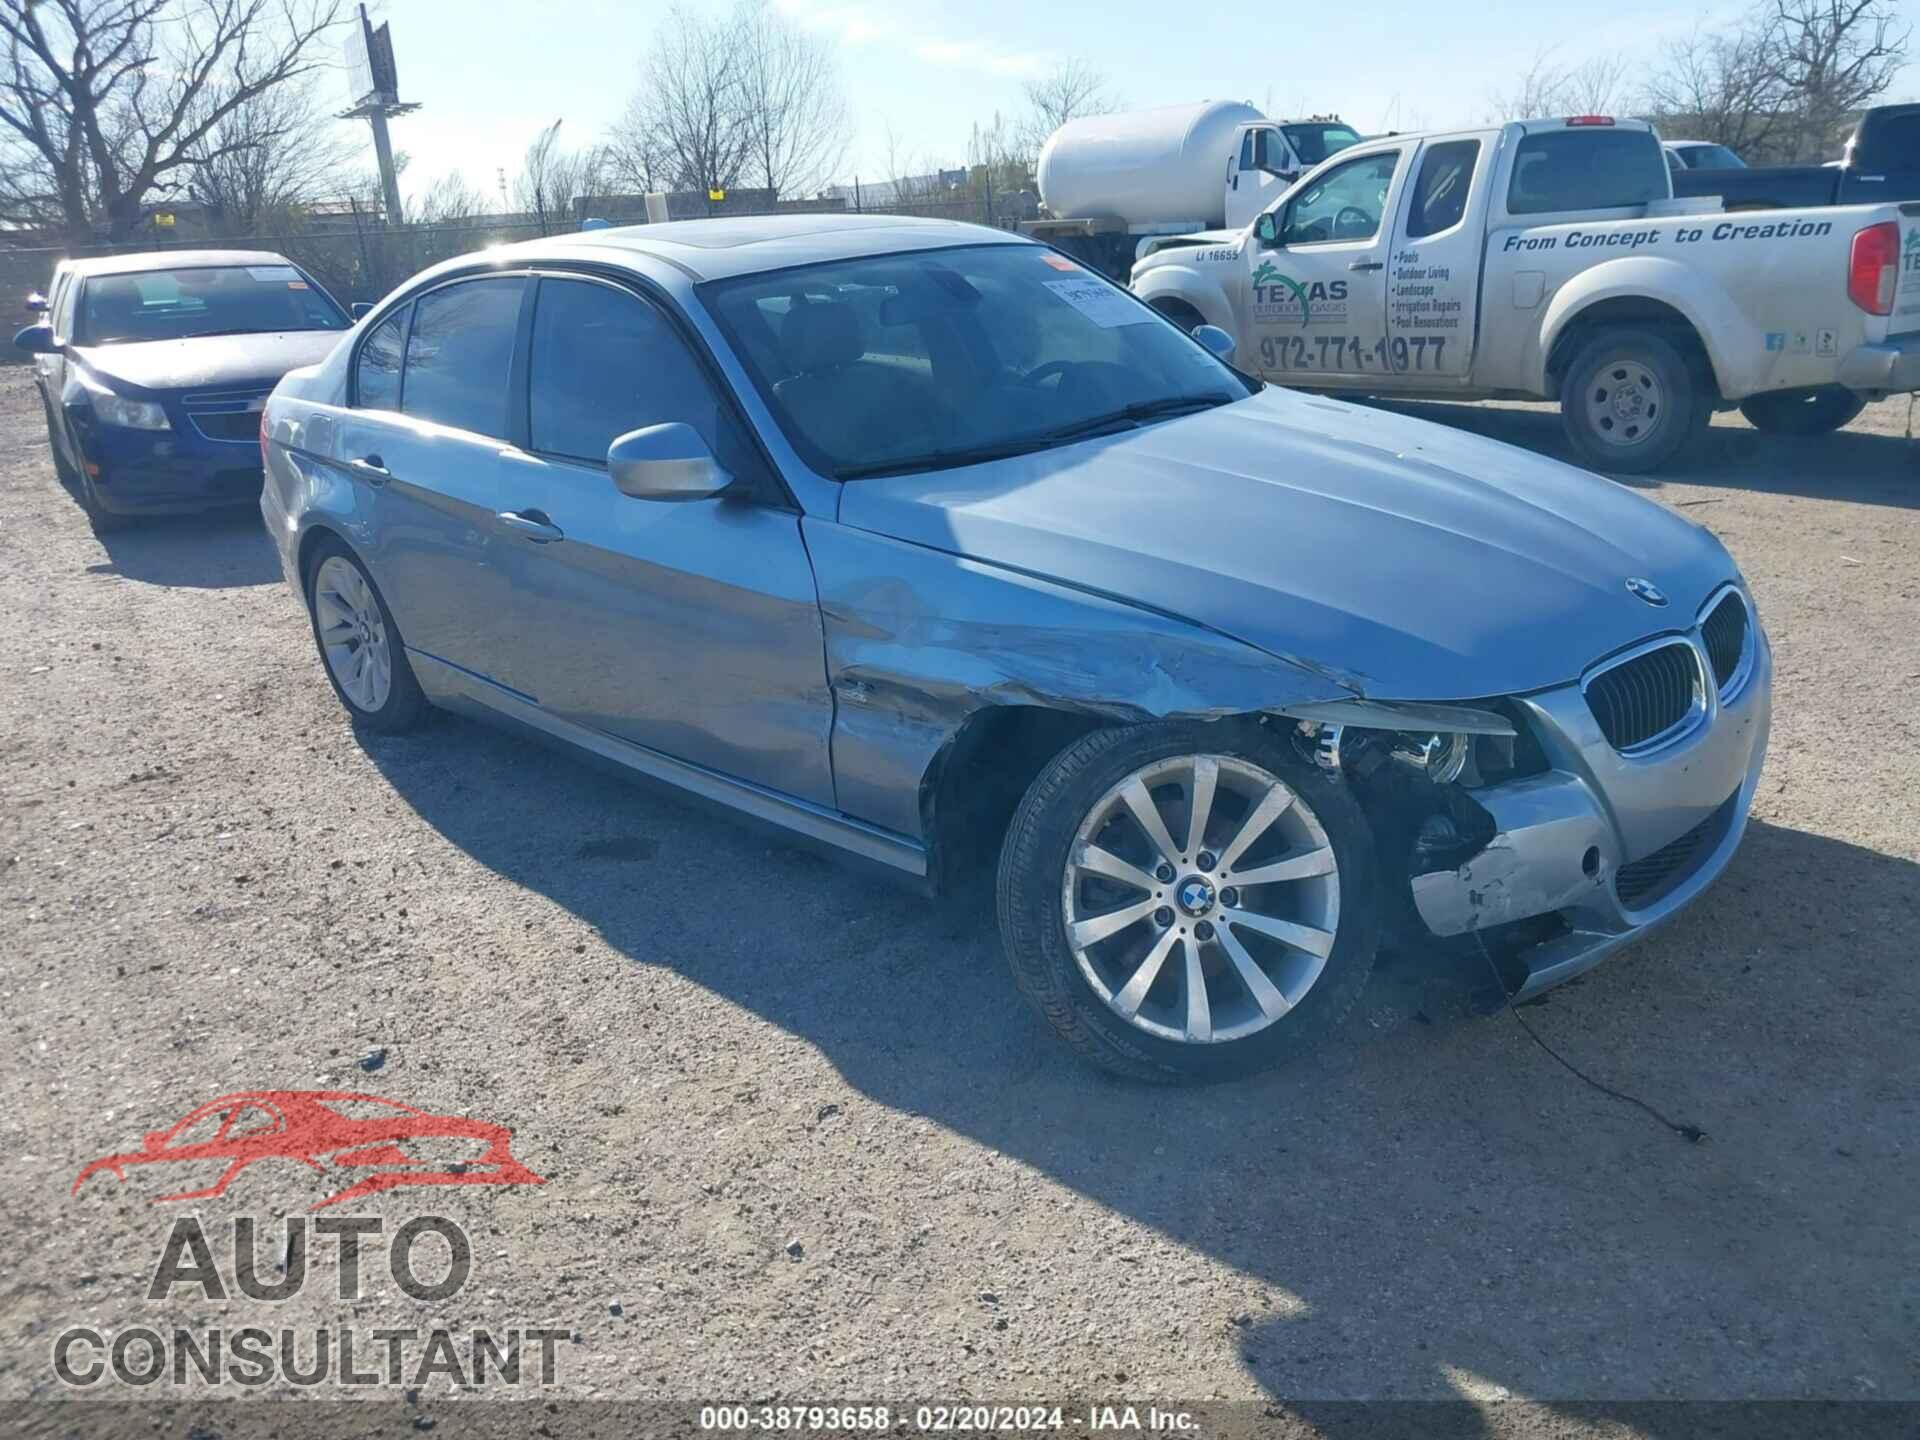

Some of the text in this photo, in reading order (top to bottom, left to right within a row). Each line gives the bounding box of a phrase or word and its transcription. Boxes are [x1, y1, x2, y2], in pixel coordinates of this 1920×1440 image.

[1503, 218, 1833, 252] From Concept to Creation
[1398, 251, 1419, 264] Pools
[1397, 265, 1450, 281] Outdoor Living
[1252, 280, 1348, 303] TEXAS
[1396, 283, 1434, 298] Landscape
[1260, 336, 1446, 371] 972-771-1977
